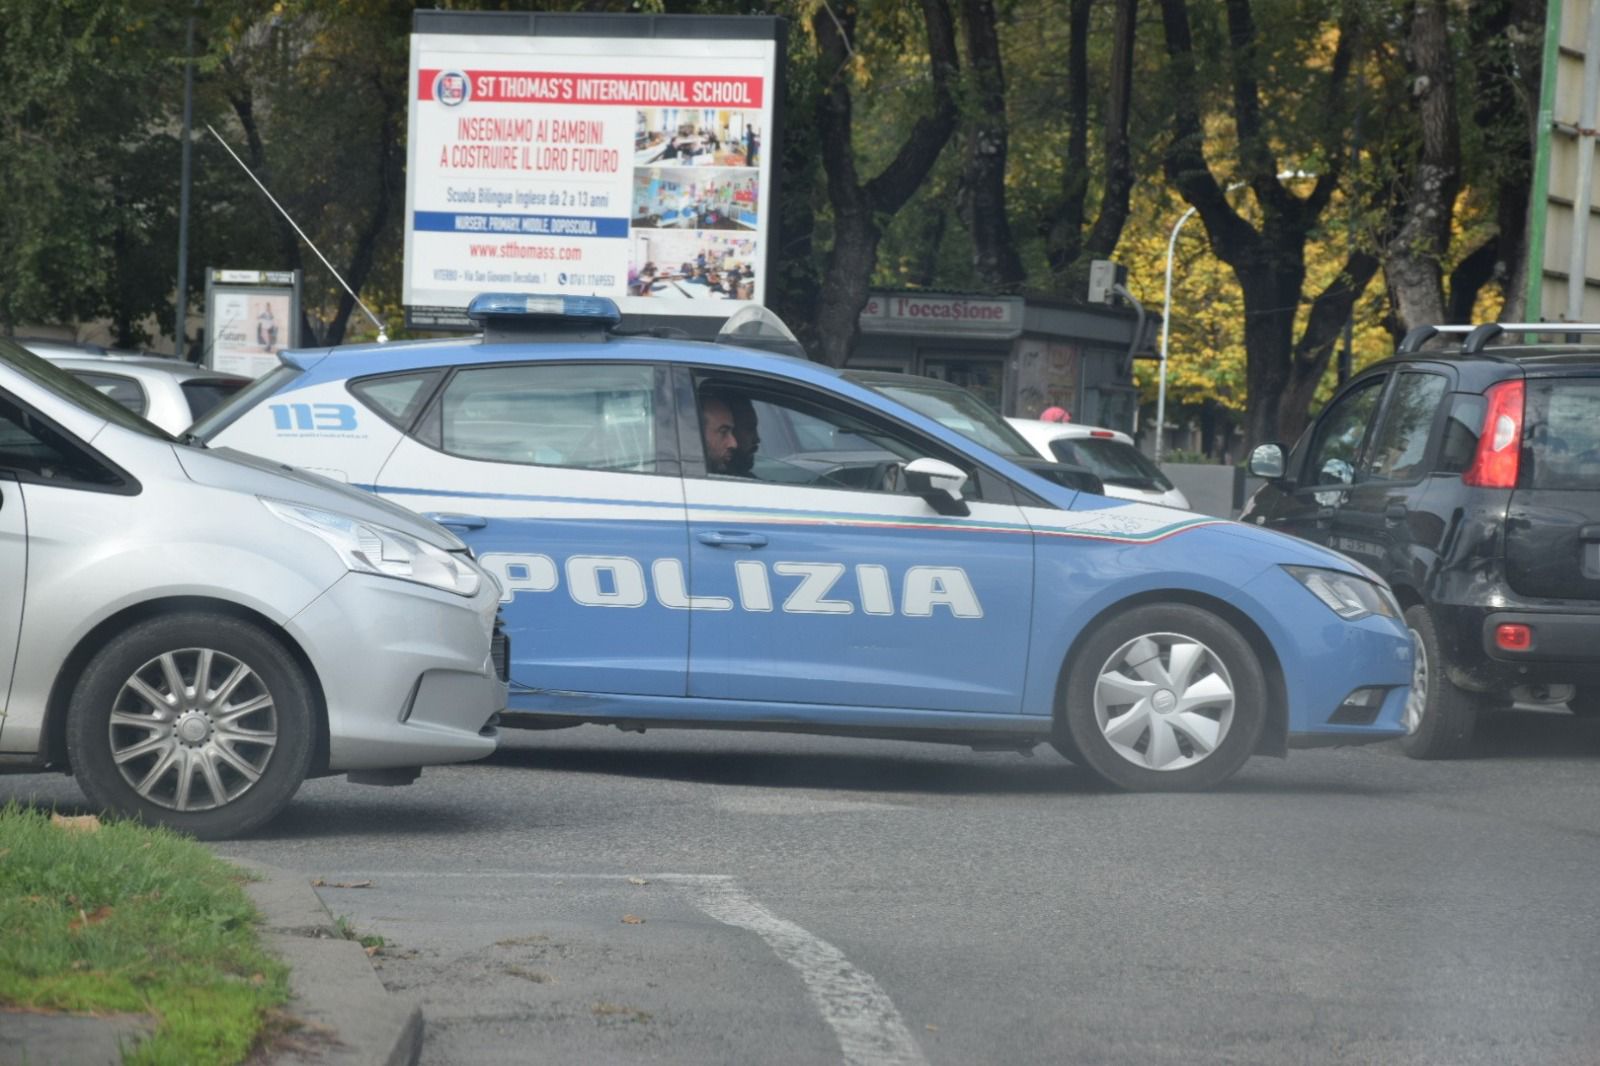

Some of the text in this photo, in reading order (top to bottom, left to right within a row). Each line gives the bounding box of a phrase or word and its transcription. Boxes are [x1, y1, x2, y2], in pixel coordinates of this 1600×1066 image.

[477, 76, 752, 103] ST THOMAS'S INTERNATIONAL SCHOOL
[458, 117, 604, 144] INSEGNIAMO AI BAMBINI
[440, 145, 618, 173] A COSTRUIRE IL LORO FUTURO
[447, 187, 475, 203] Scuola
[478, 187, 513, 208] Bilingue
[549, 191, 560, 206] da
[561, 191, 568, 207] 2
[569, 195, 576, 207] a
[578, 191, 588, 207] 13
[590, 191, 609, 208] anni
[470, 242, 582, 261] www.stthomass.com
[268, 403, 358, 431] 113
[478, 552, 984, 618] POLIZIA
